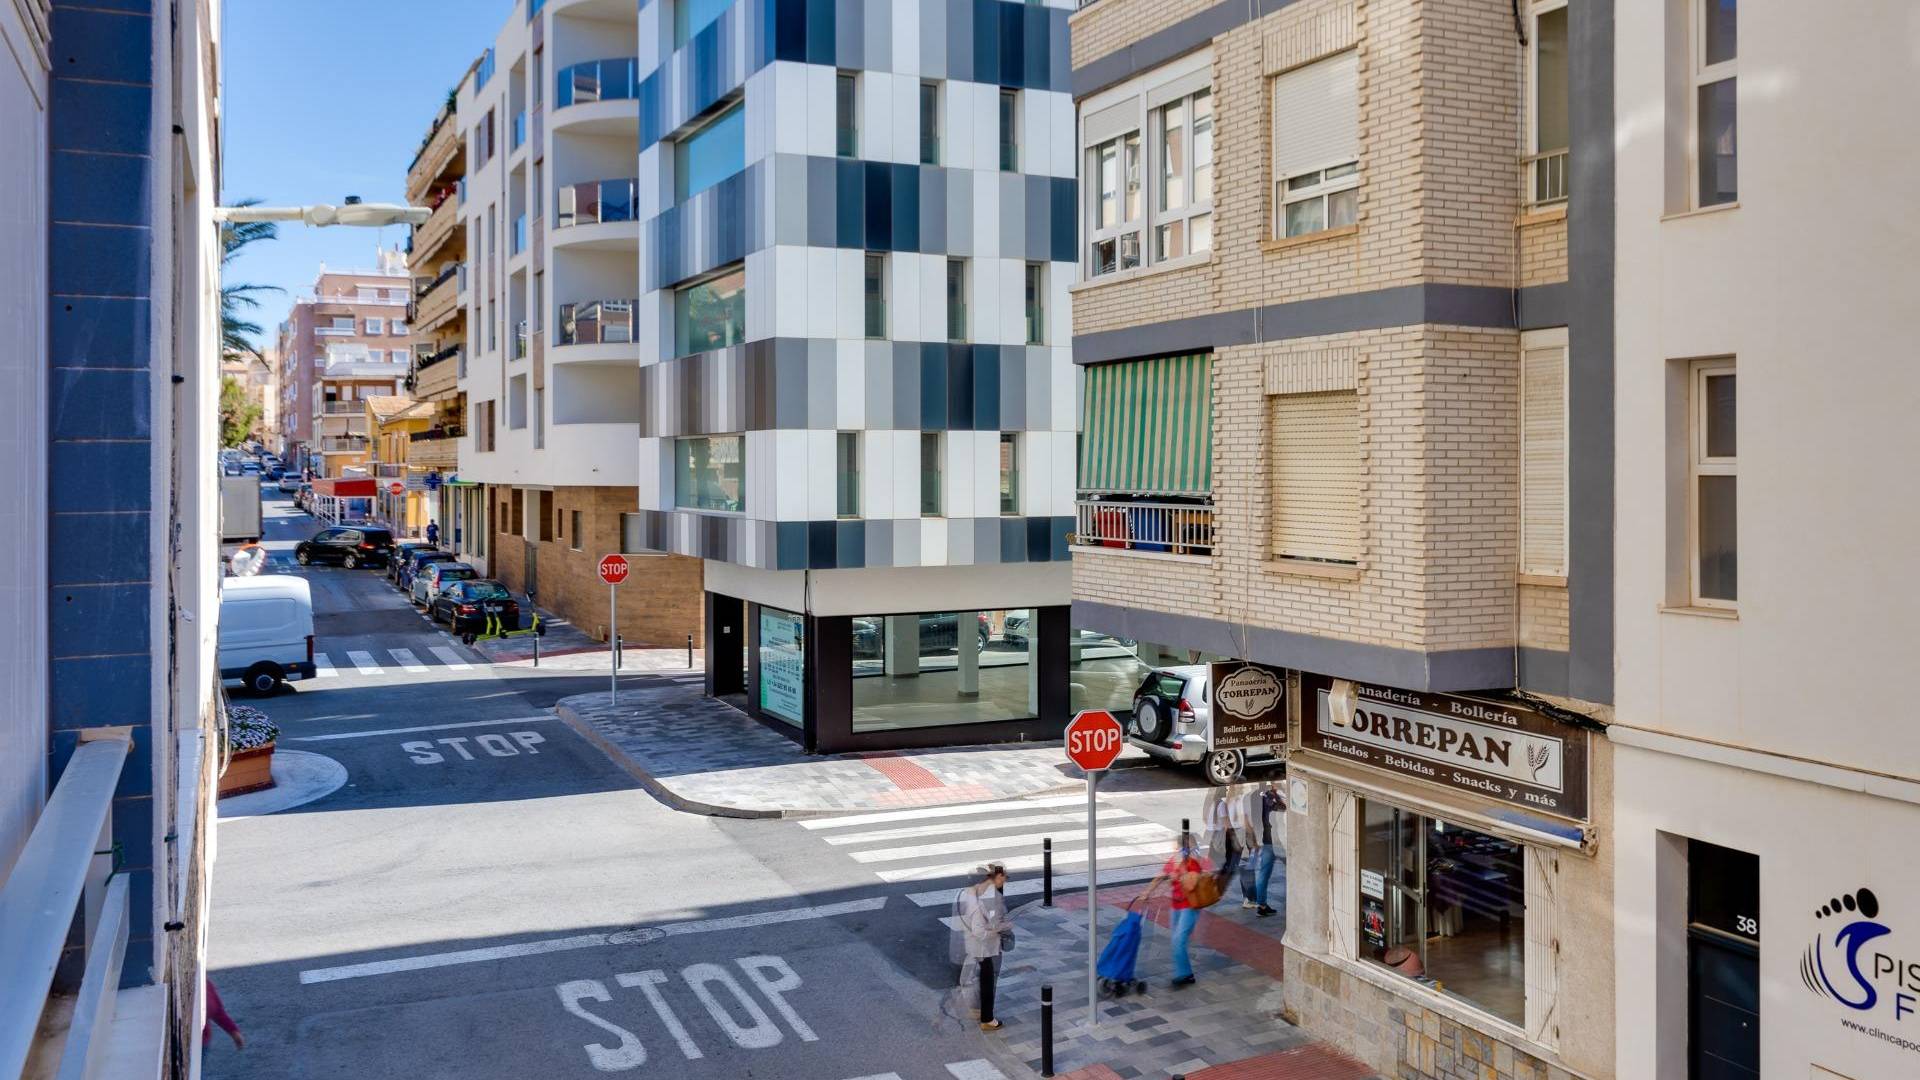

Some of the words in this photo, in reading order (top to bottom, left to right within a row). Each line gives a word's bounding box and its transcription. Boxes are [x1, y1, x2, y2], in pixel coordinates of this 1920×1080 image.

[601, 563, 627, 575] STOP
[1223, 687, 1275, 698] TORREPAN
[1358, 686, 1421, 706] anadería
[1450, 701, 1518, 726] Bollería
[1254, 722, 1277, 730] Helados
[1332, 708, 1512, 767] ORREPAN
[400, 731, 546, 765] STOP
[1070, 728, 1119, 753] STOP
[1215, 737, 1239, 745] Bebidas
[1245, 734, 1265, 742] Snacks
[1323, 739, 1369, 759] Helados
[1384, 754, 1435, 776] Bebidas
[1452, 771, 1502, 793] Snacks
[1508, 787, 1518, 799] y
[1525, 792, 1557, 807] más
[1736, 914, 1758, 935] 38
[554, 955, 820, 1072] STOP
